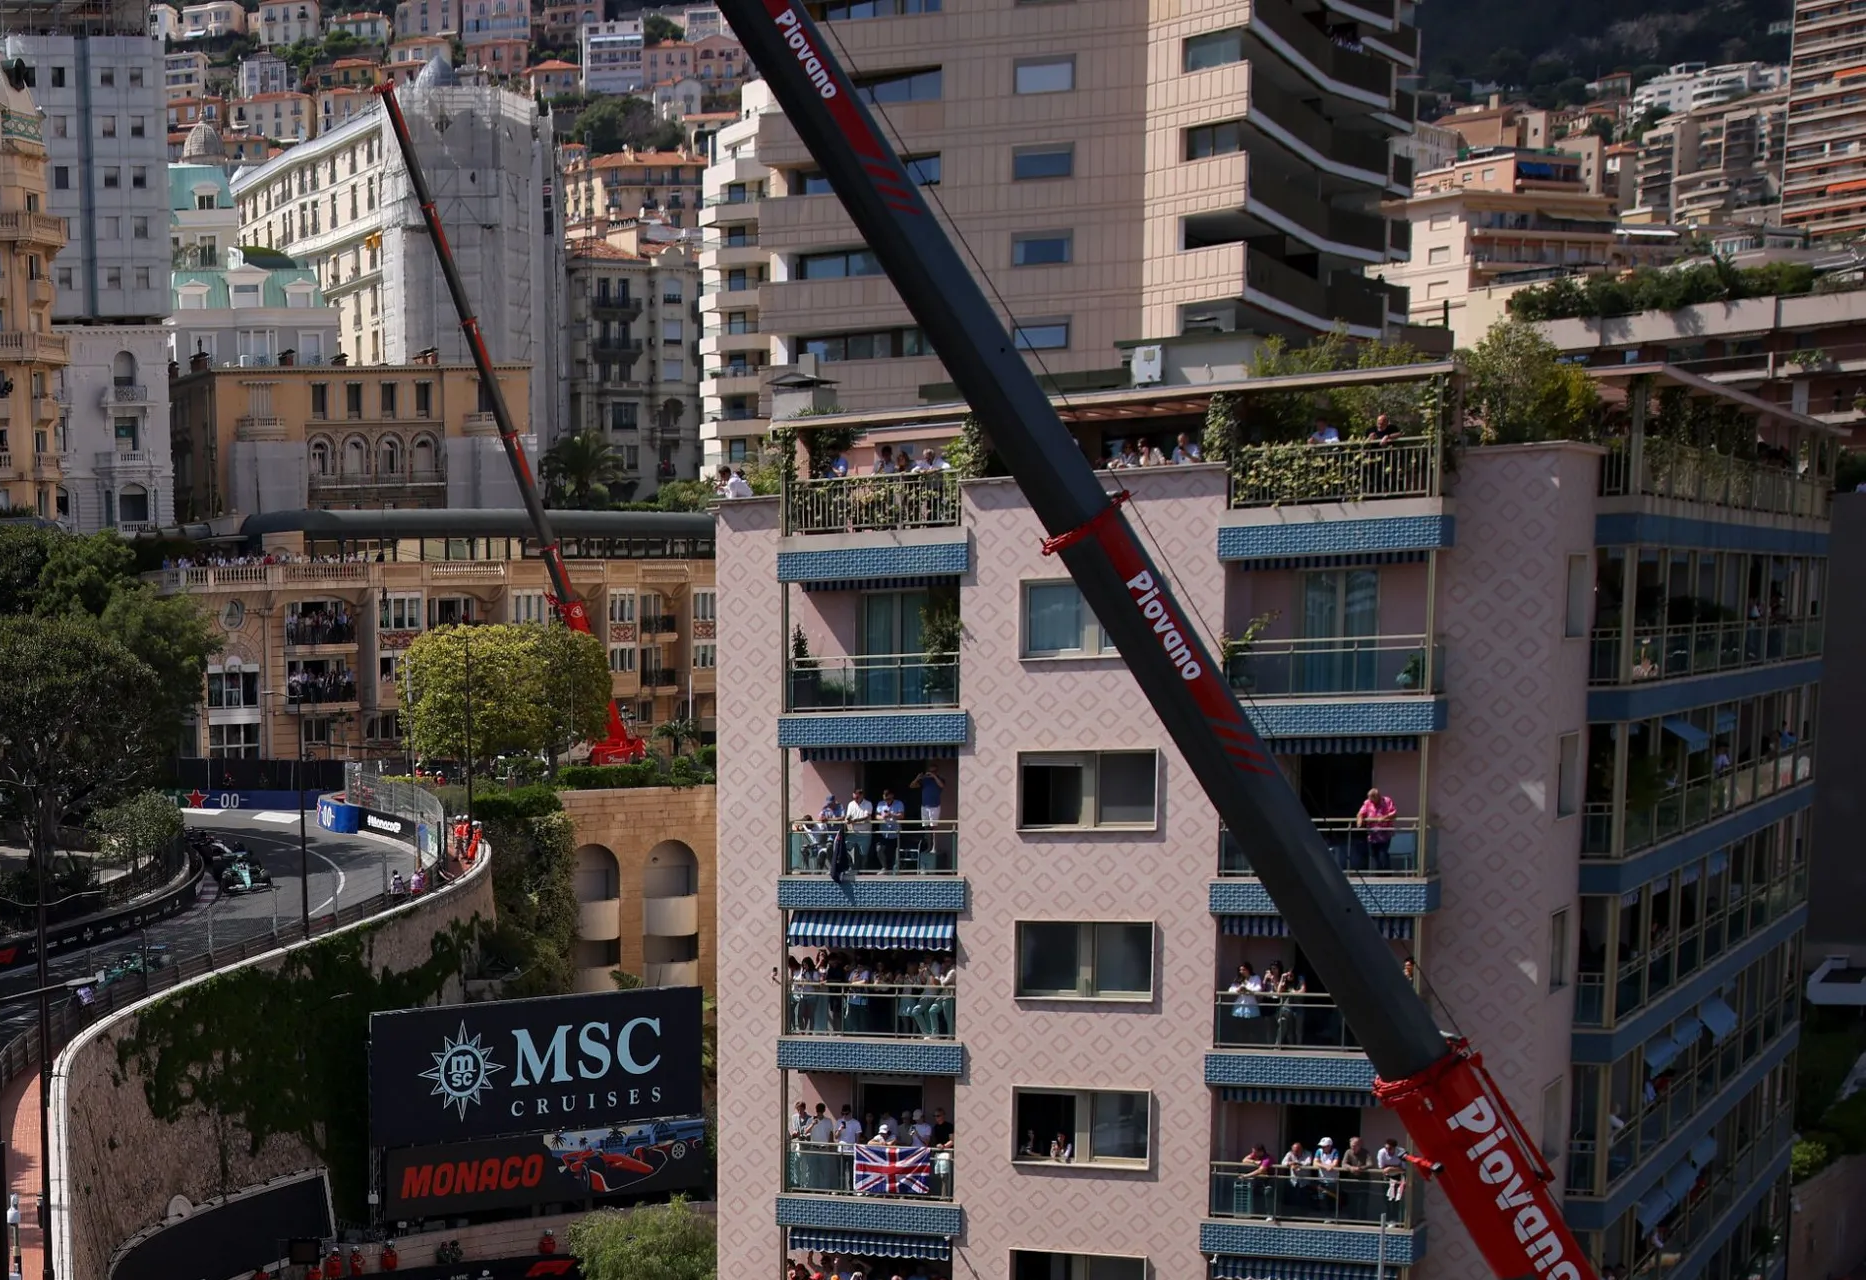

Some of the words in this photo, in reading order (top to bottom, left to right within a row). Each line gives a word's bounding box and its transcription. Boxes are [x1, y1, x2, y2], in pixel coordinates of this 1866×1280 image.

[775, 8, 837, 99] Piovano
[1126, 570, 1201, 680] Piovano
[511, 1017, 661, 1087] MSC
[511, 1086, 662, 1117] CRUISES
[401, 1154, 544, 1199] MONACO
